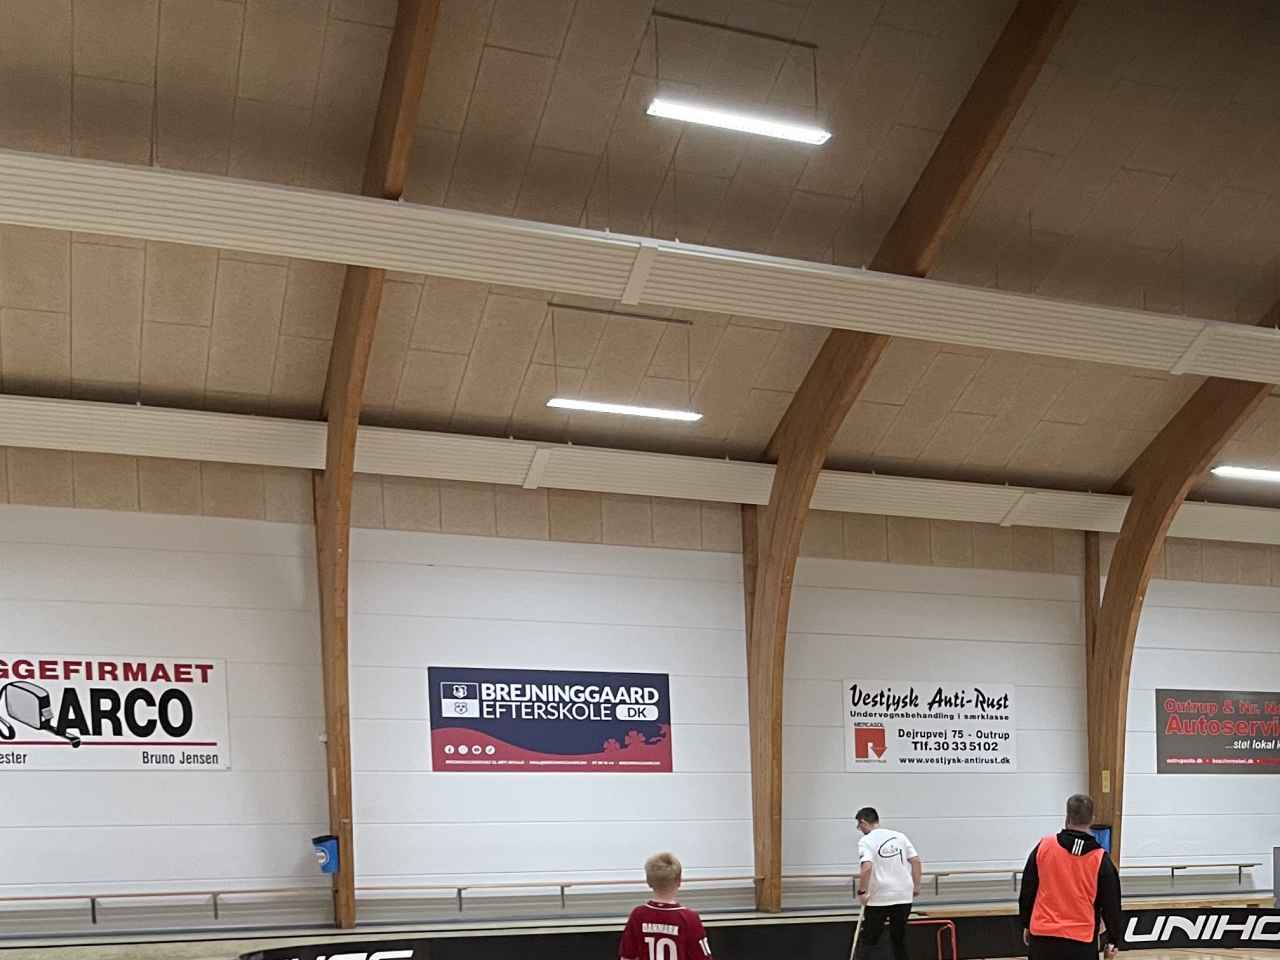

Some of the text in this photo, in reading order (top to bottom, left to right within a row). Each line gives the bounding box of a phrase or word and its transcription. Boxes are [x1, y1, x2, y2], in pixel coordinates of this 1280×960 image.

[481, 683, 659, 704] BREJNINGGAARD
[849, 684, 1010, 712] Vestjysk Anti-Rust
[482, 701, 647, 720] EFTERSKOLE DK
[850, 711, 954, 720] Undervognsbehandling
[951, 730, 963, 739] 75
[976, 730, 1010, 741] Outrup
[912, 741, 932, 751] Tlf.
[1252, 739, 1275, 749] lokal
[142, 752, 175, 764] Bruno
[179, 753, 219, 764] Jensen
